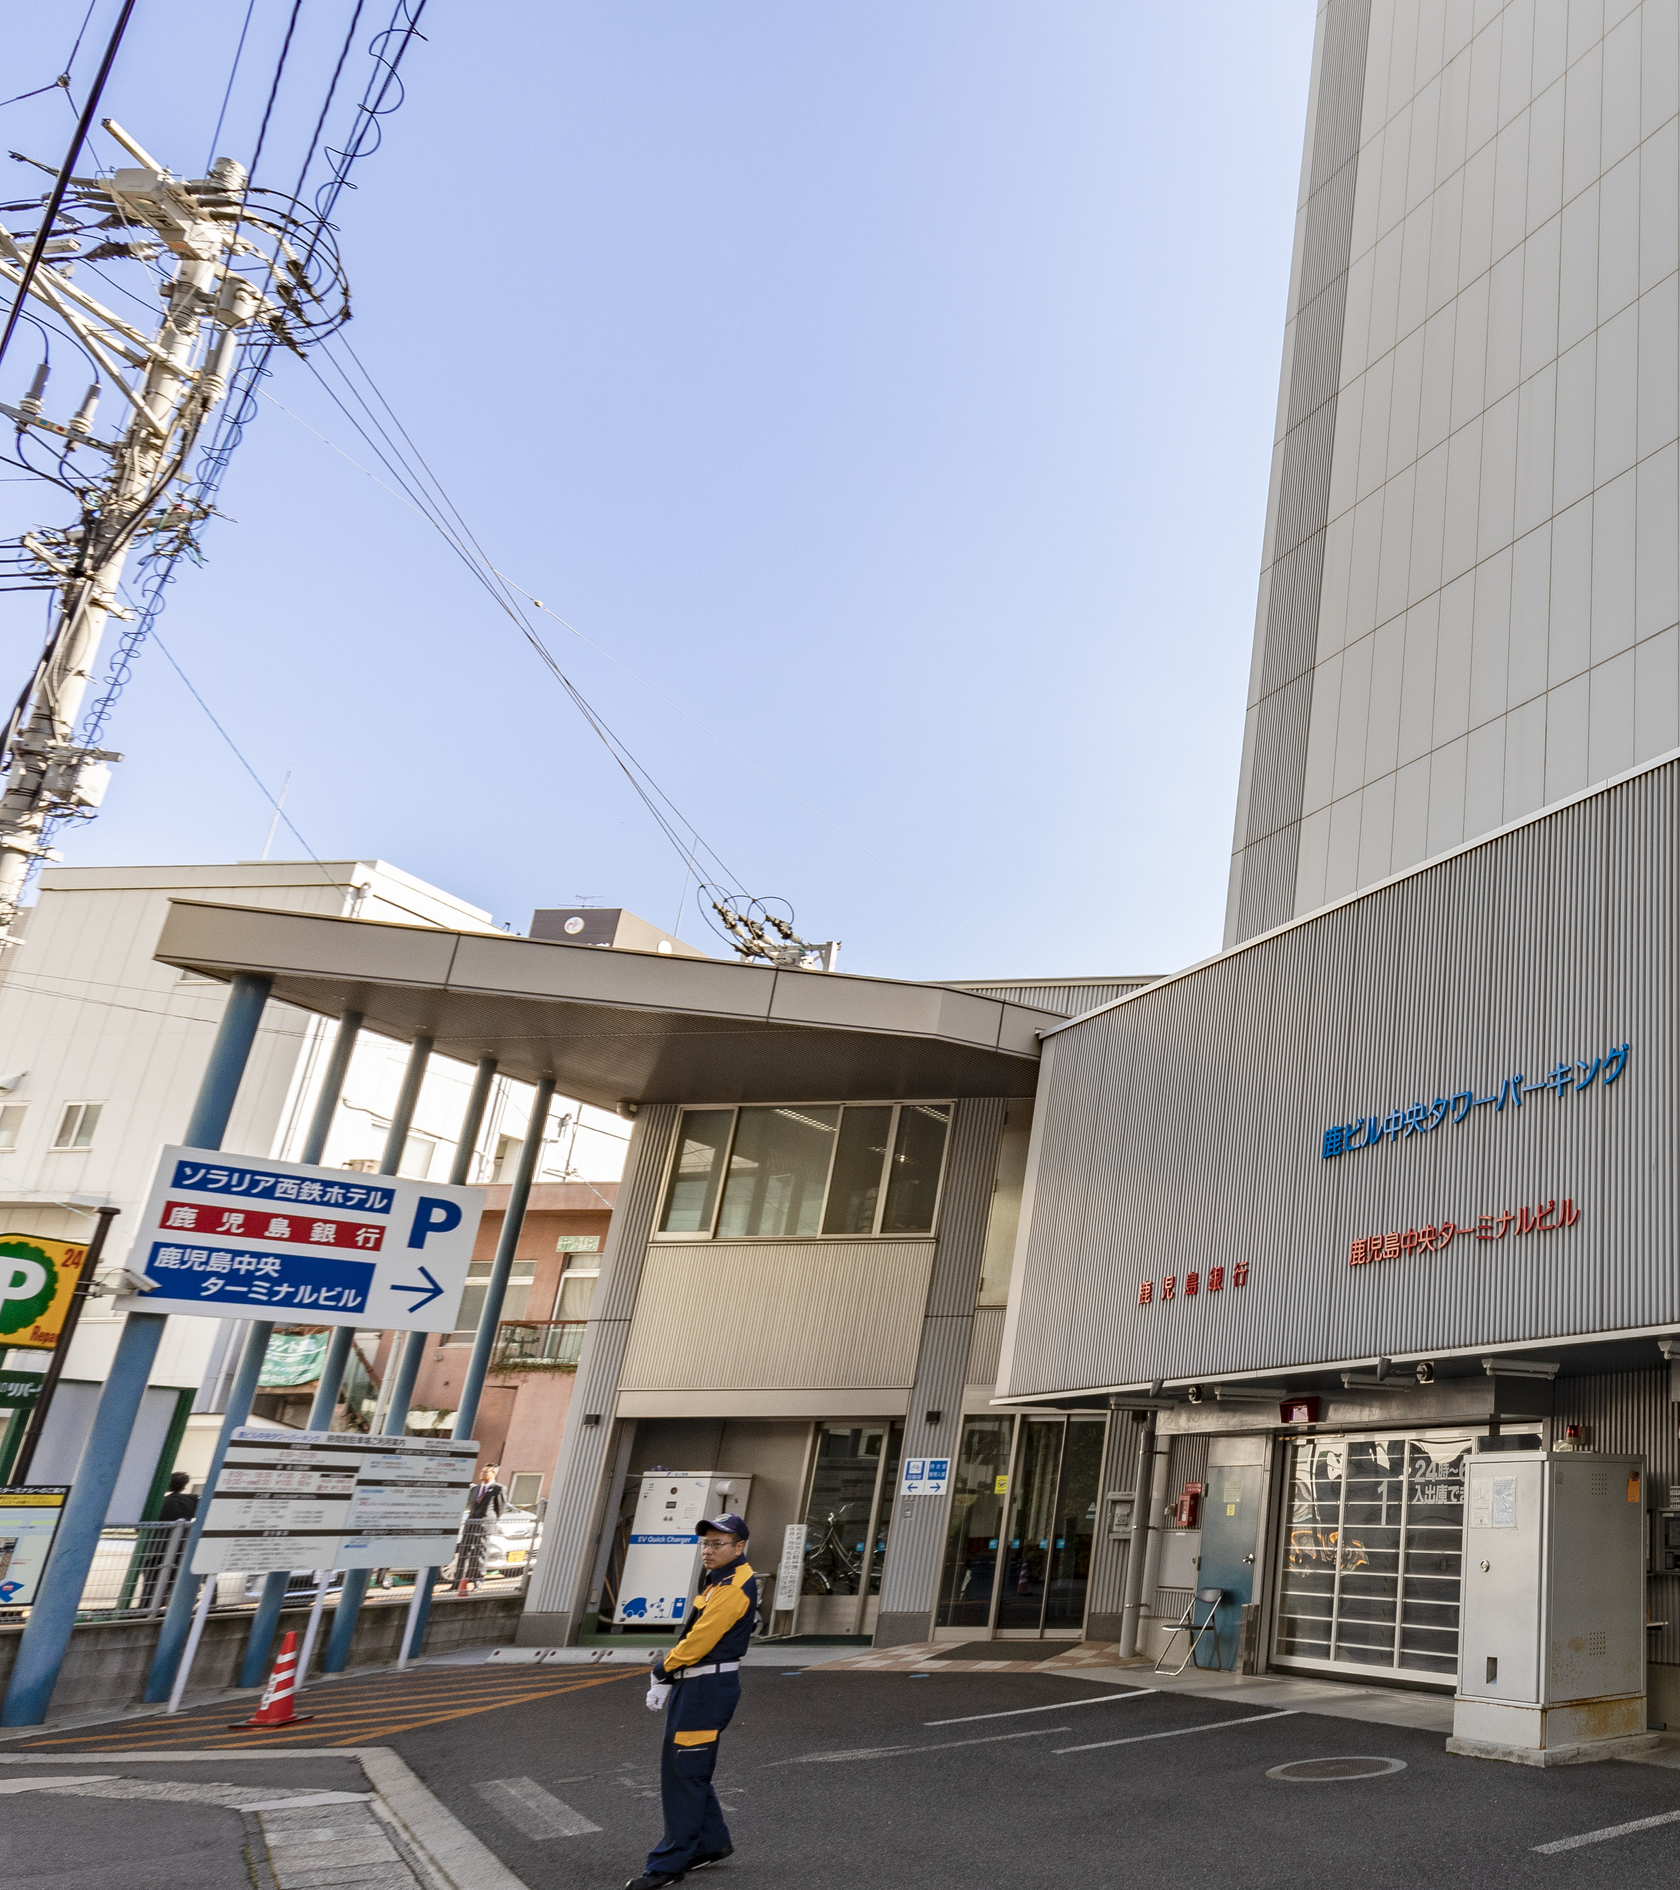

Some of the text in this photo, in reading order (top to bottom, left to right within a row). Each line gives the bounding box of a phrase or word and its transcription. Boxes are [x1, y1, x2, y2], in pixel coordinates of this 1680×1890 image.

[1321, 1043, 1630, 1159] 鹿ビル中央タワーパーキング
[182, 1165, 389, 1211] ソラリア西鉄ホテル
[407, 1196, 463, 1250] P
[1348, 1198, 1580, 1267] 鹿児島中央ターミナルビル
[154, 1246, 280, 1277] 鹿児島中央
[200, 1277, 363, 1308] ターミナルビル
[648, 1535, 666, 1543] Quick
[666, 1536, 692, 1545] Charger
